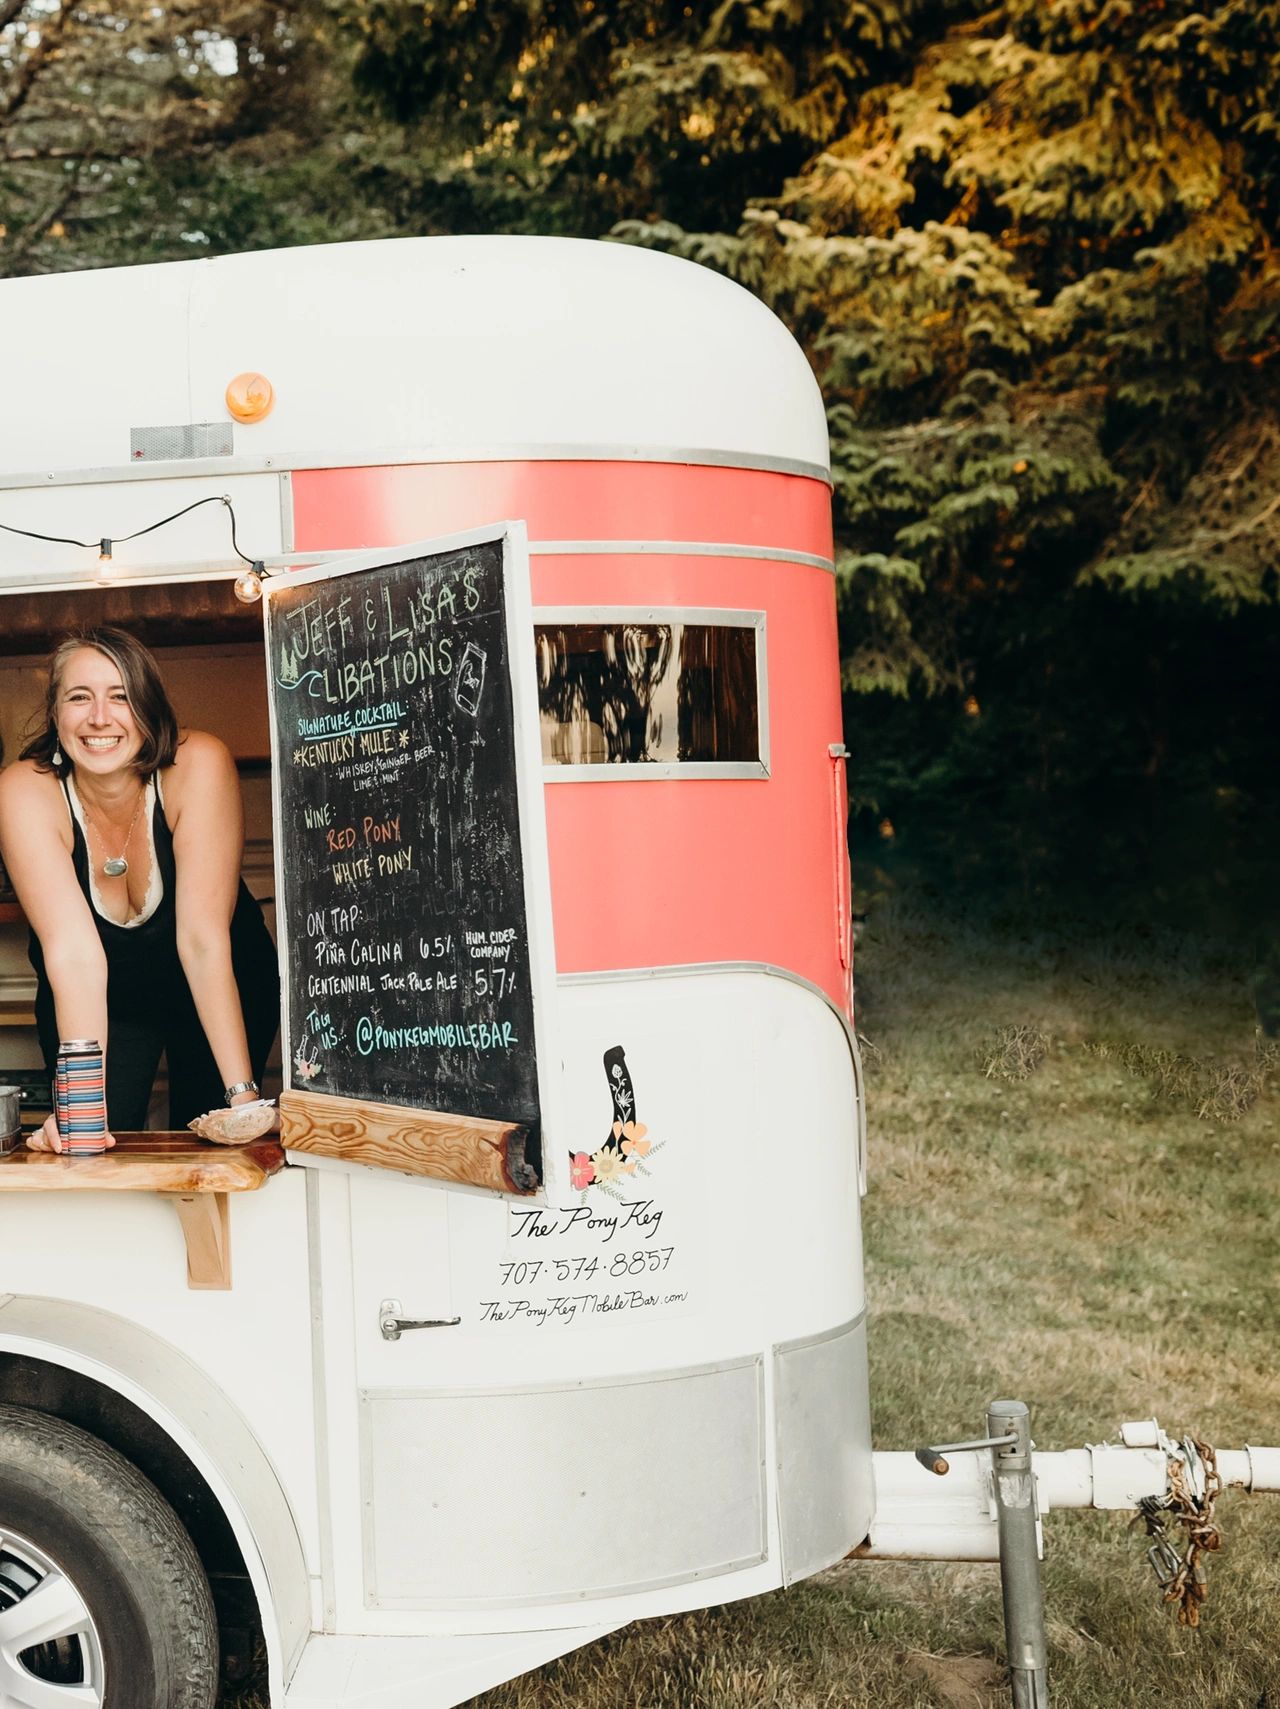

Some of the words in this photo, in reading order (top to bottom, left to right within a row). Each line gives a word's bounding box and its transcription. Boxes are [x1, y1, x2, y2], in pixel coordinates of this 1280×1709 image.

[287, 597, 352, 660] JEFF
[384, 569, 480, 641] LISA'S
[324, 638, 453, 704] LIBATIONS
[298, 711, 352, 736] SIGNATURE
[300, 733, 355, 768] KENTUCKY
[360, 729, 394, 757] MULE
[414, 745, 436, 762] BEER
[304, 803, 337, 829] WINE:
[326, 827, 356, 852] RED
[363, 816, 400, 847] PONY
[332, 858, 372, 885] WHITE
[378, 846, 412, 876] PONY
[307, 910, 325, 937] ON
[331, 904, 364, 934] TAP:
[489, 928, 518, 944] CIDER
[315, 941, 346, 966] PIÑA
[351, 938, 403, 966] CALINA
[470, 944, 510, 963] COMPANY
[308, 974, 375, 998] CENTENNIAL
[380, 973, 405, 991] JACK
[407, 971, 432, 992] PALE
[436, 971, 457, 991] ALE
[306, 1009, 331, 1035] TAG
[356, 1016, 519, 1056] @PONYKEGMOBILEBAR
[511, 1210, 558, 1238] The
[559, 1206, 618, 1243] Pony
[619, 1200, 663, 1239] Keg
